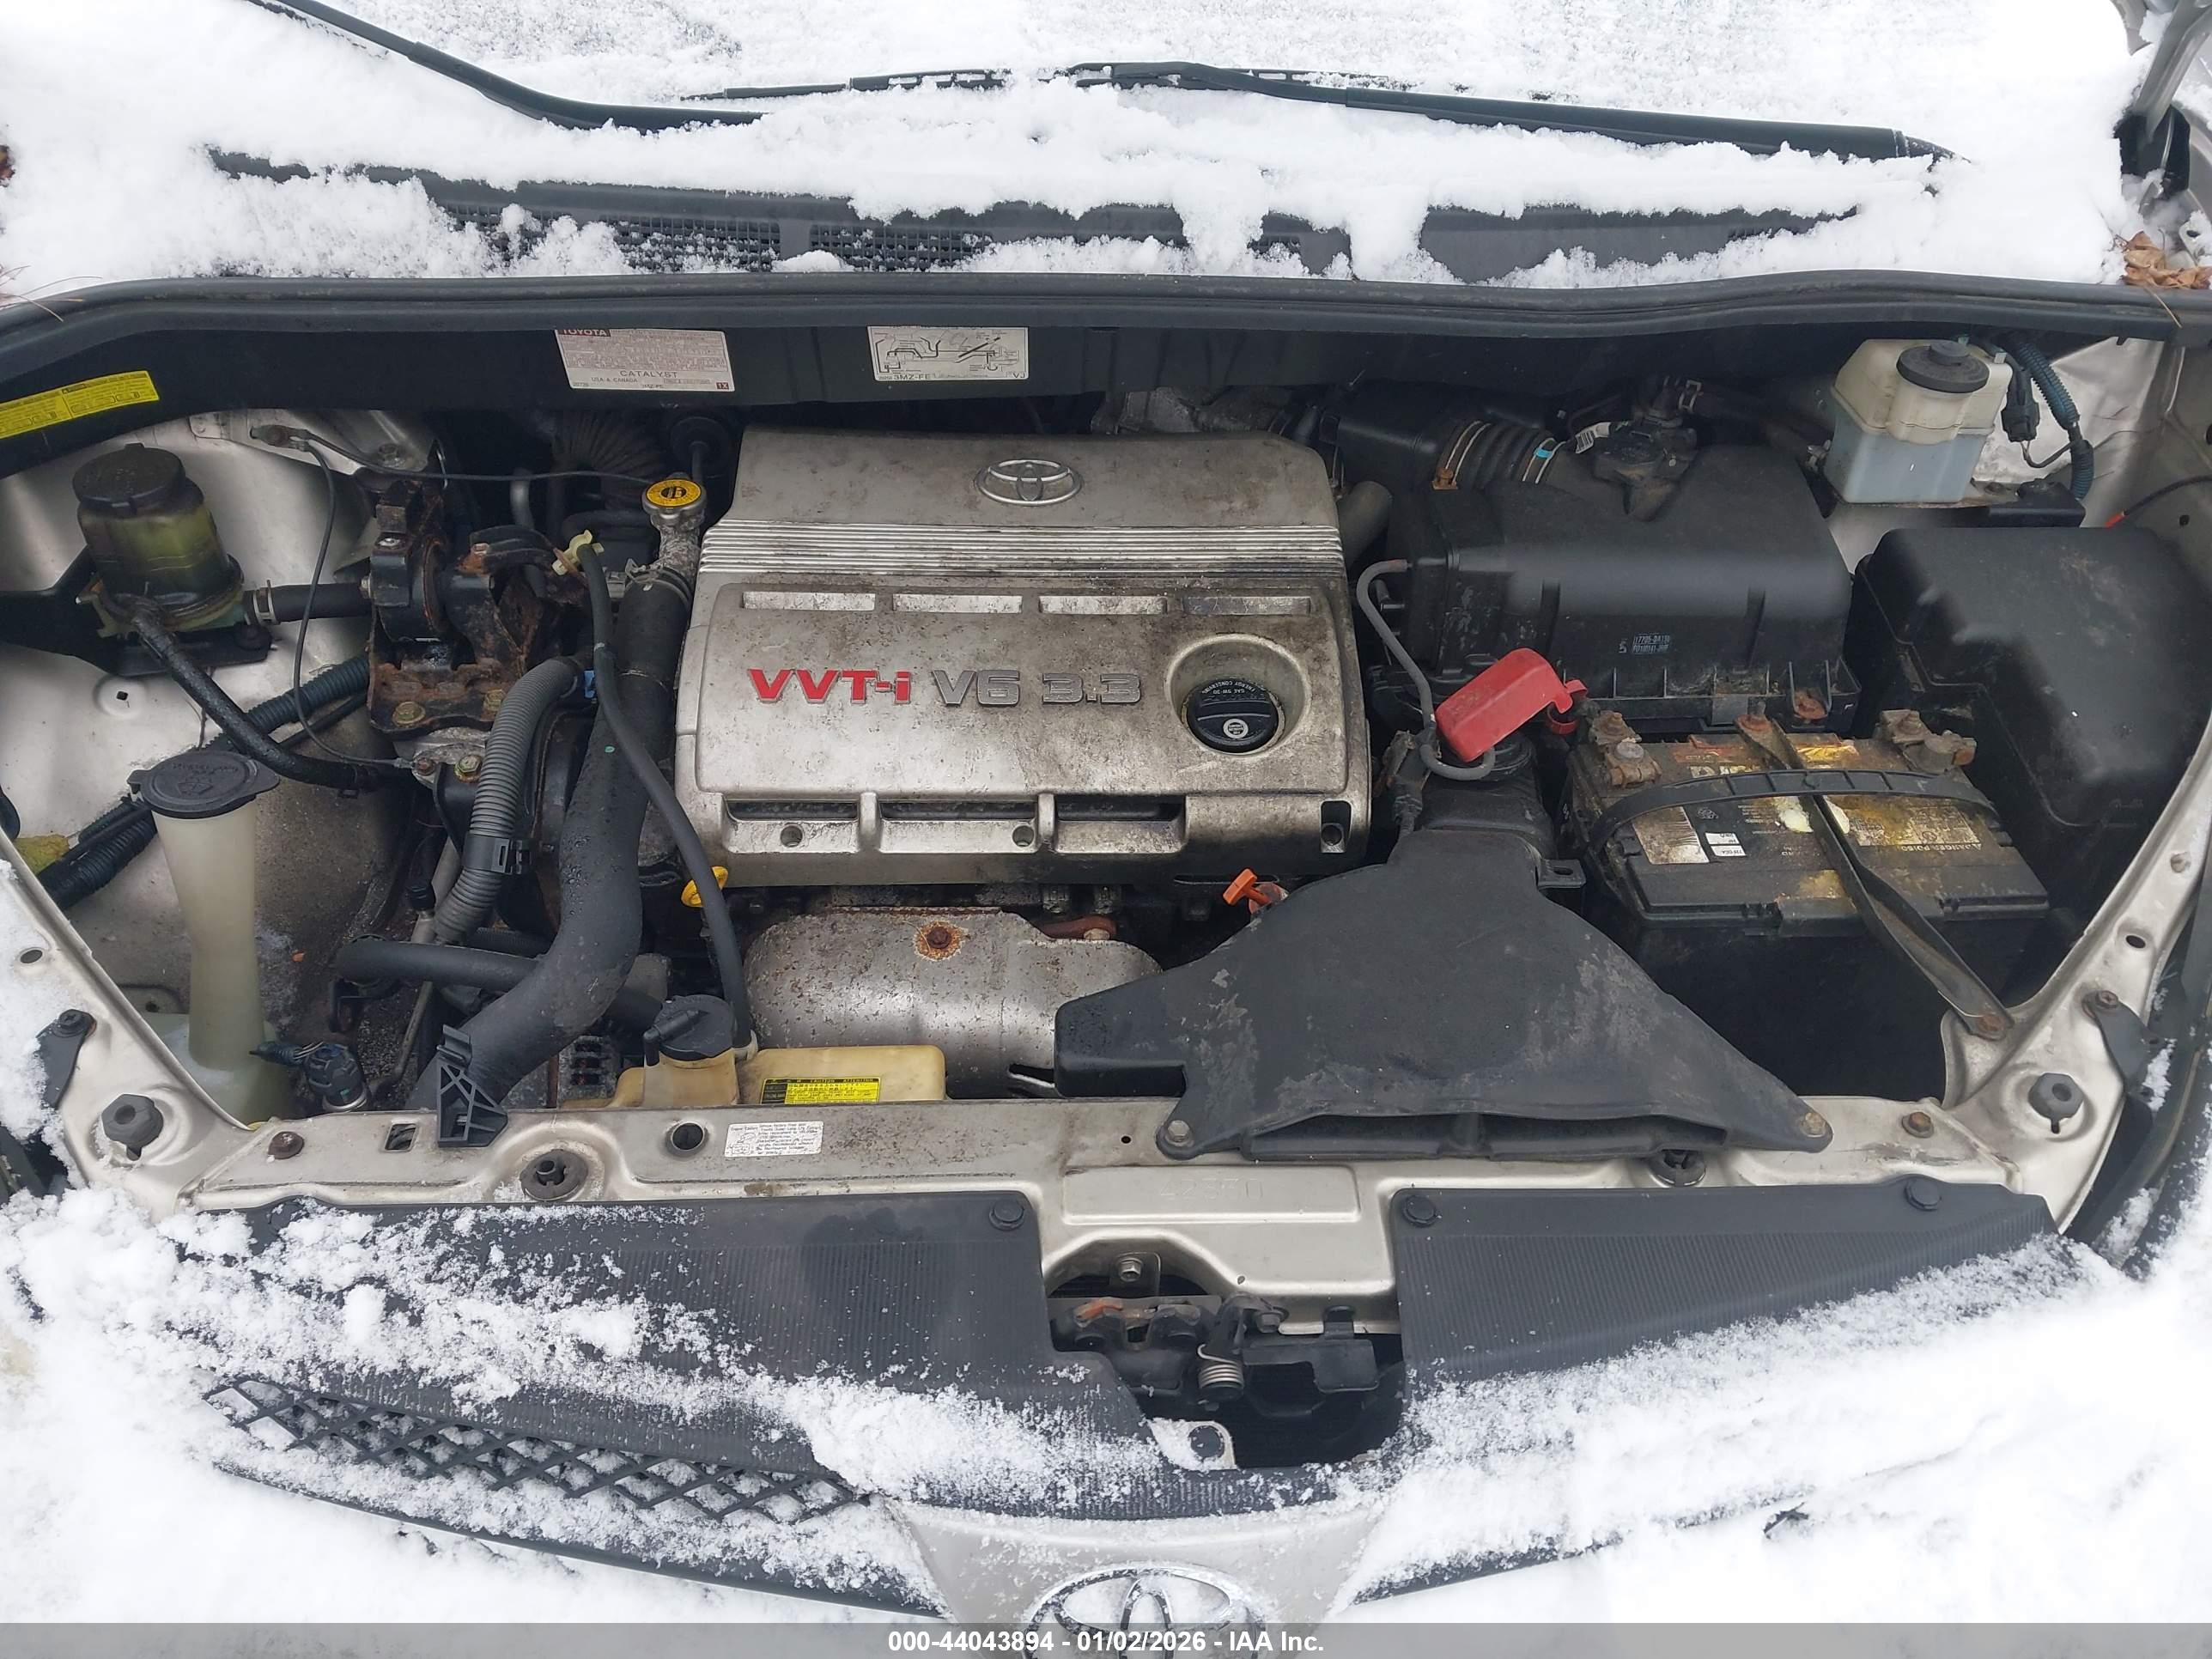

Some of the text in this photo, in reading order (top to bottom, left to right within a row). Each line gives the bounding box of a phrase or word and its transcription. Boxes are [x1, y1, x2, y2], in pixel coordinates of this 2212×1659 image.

[620, 370, 678, 379] CATALYST
[747, 668, 1143, 707] VVT-i V6 3.3
